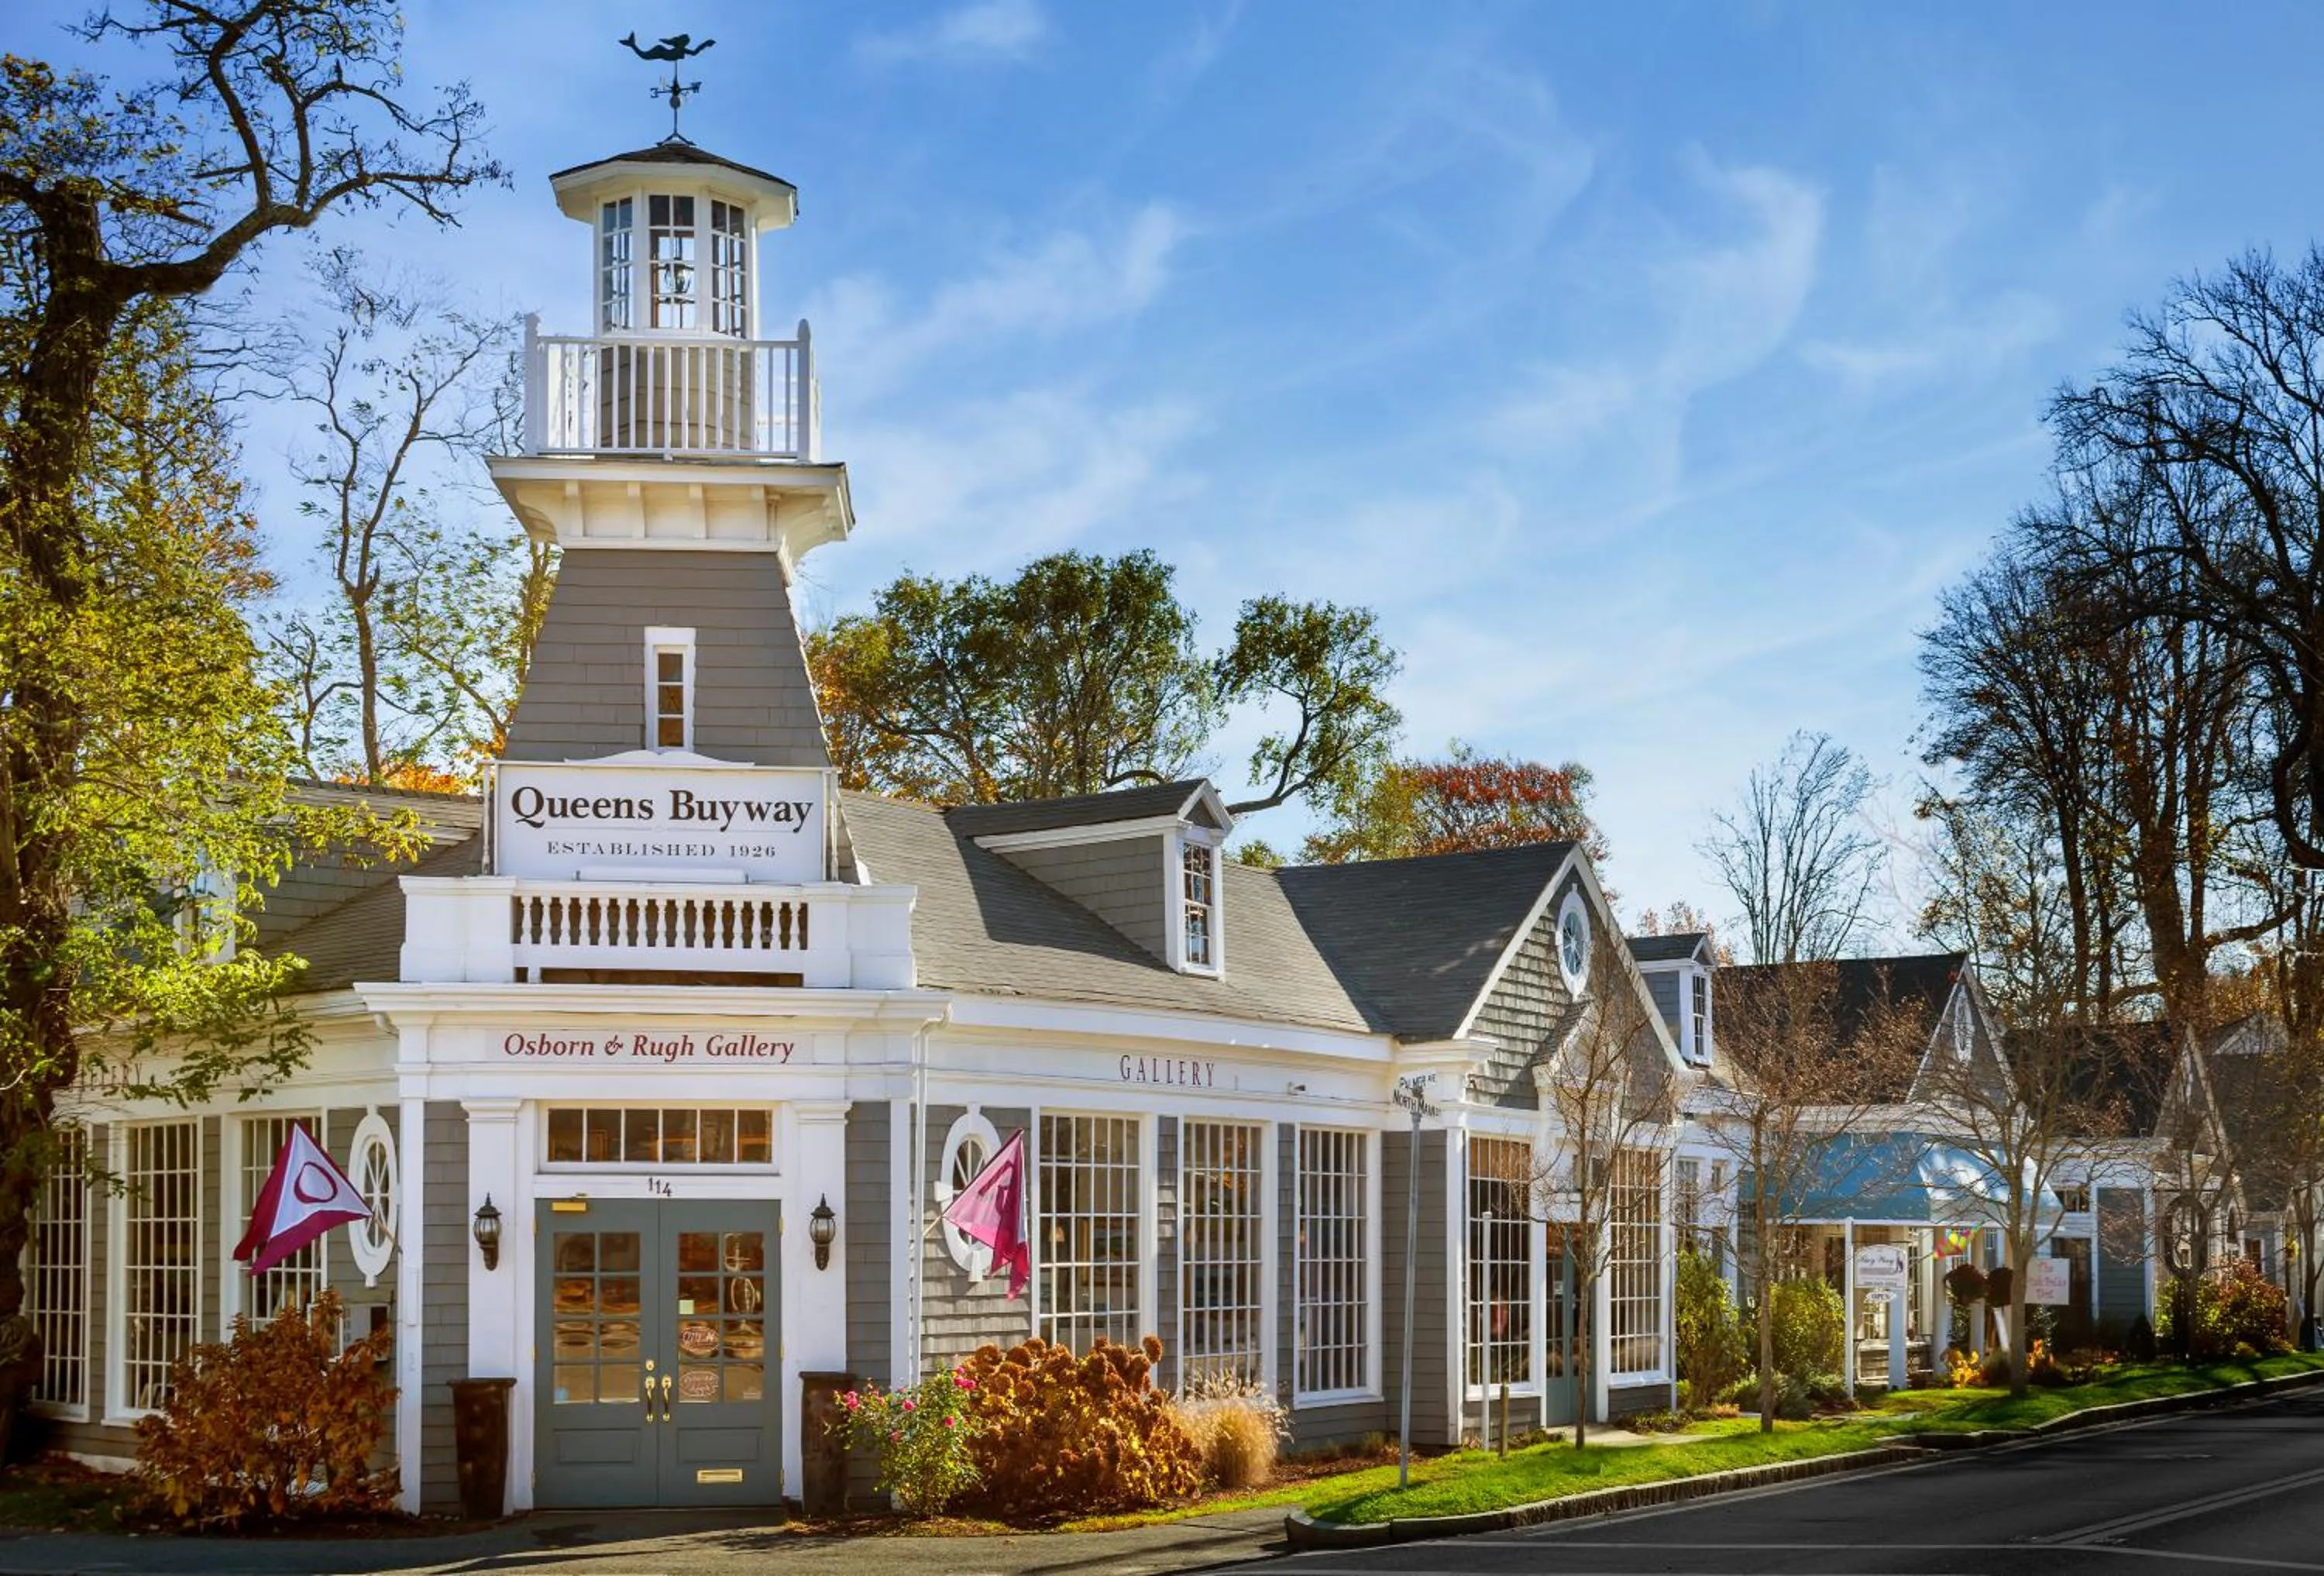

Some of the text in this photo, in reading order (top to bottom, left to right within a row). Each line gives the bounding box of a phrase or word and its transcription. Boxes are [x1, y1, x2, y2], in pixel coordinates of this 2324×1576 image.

[511, 786, 813, 833] Queens Buyway
[547, 841, 776, 858] ESTABLISHED 1926
[504, 1033, 794, 1064] Osborn & Rugh Gallery
[1119, 1054, 1215, 1087] GALLERY
[1393, 1089, 1417, 1112] NORTH
[648, 1177, 673, 1197] 114
